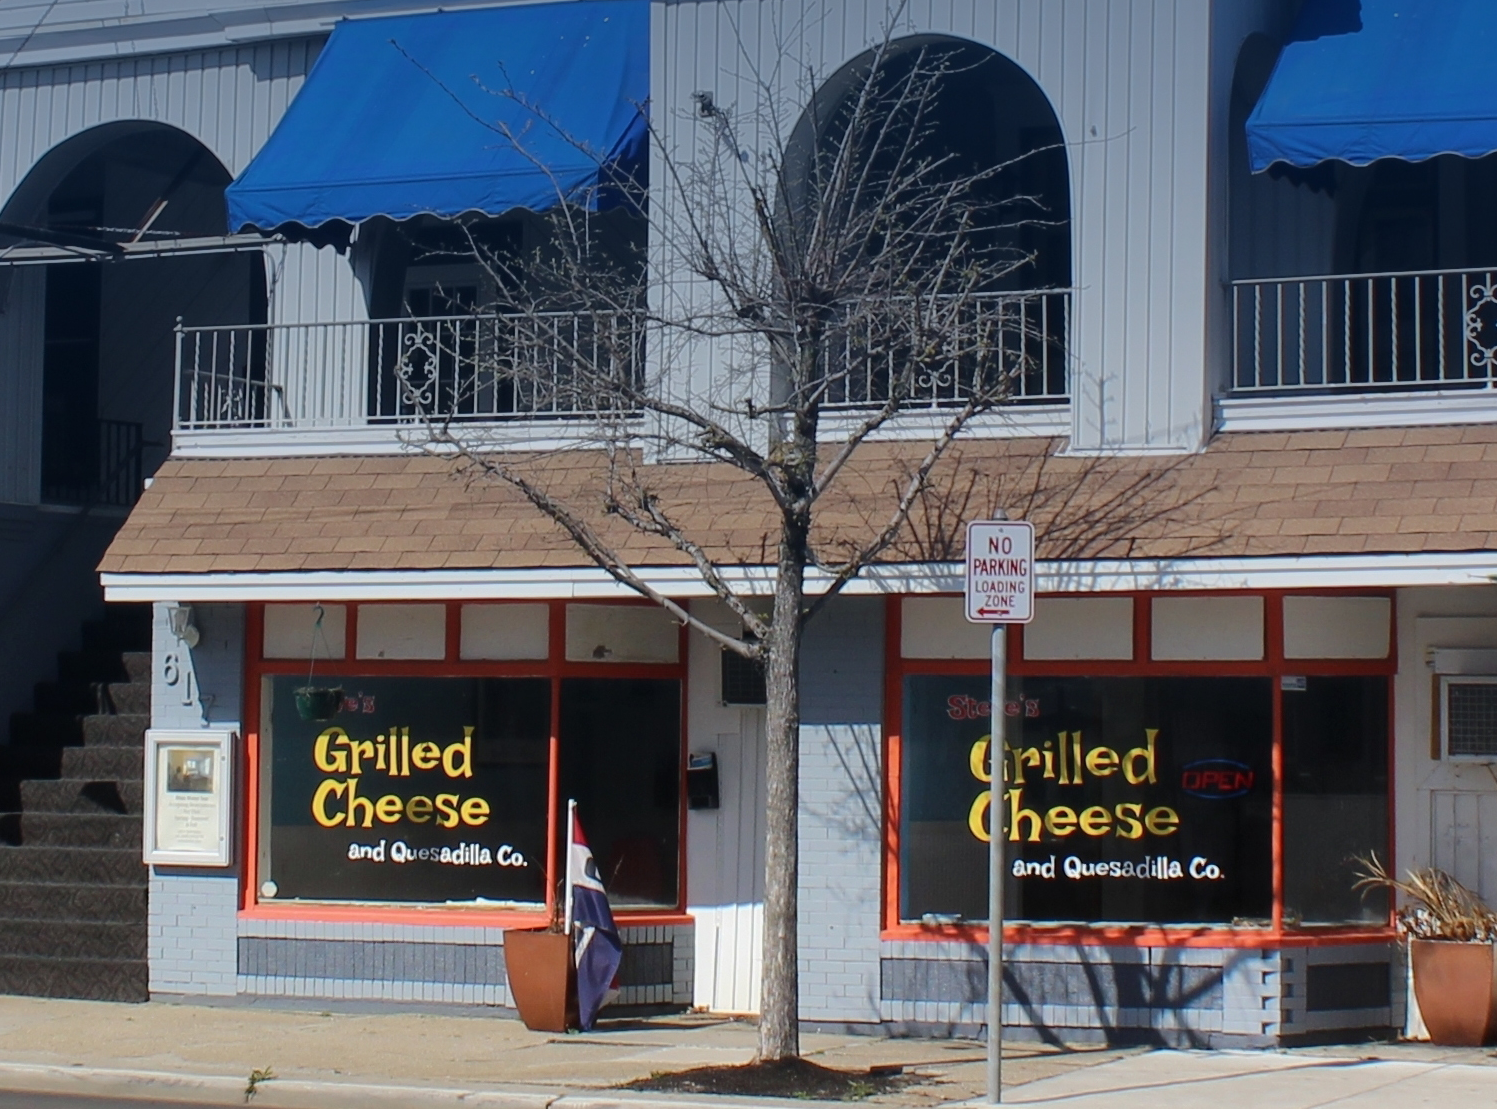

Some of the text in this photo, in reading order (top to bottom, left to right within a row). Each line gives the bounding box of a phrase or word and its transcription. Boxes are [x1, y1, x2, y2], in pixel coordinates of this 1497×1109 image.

[989, 536, 1012, 555] NO
[973, 558, 1027, 577] PARKING
[975, 580, 1025, 594] LOADING
[985, 594, 1016, 608] ZONE
[947, 693, 1041, 720] Stee's
[313, 725, 475, 778] Grilled
[968, 728, 1160, 785] Grilled
[1182, 771, 1254, 790] OPEN
[311, 777, 491, 829] Cheese
[967, 787, 1180, 844] Cheese
[348, 839, 529, 867] and Quesadilla Co.
[1012, 854, 1226, 881] and Quesadilla Co.
